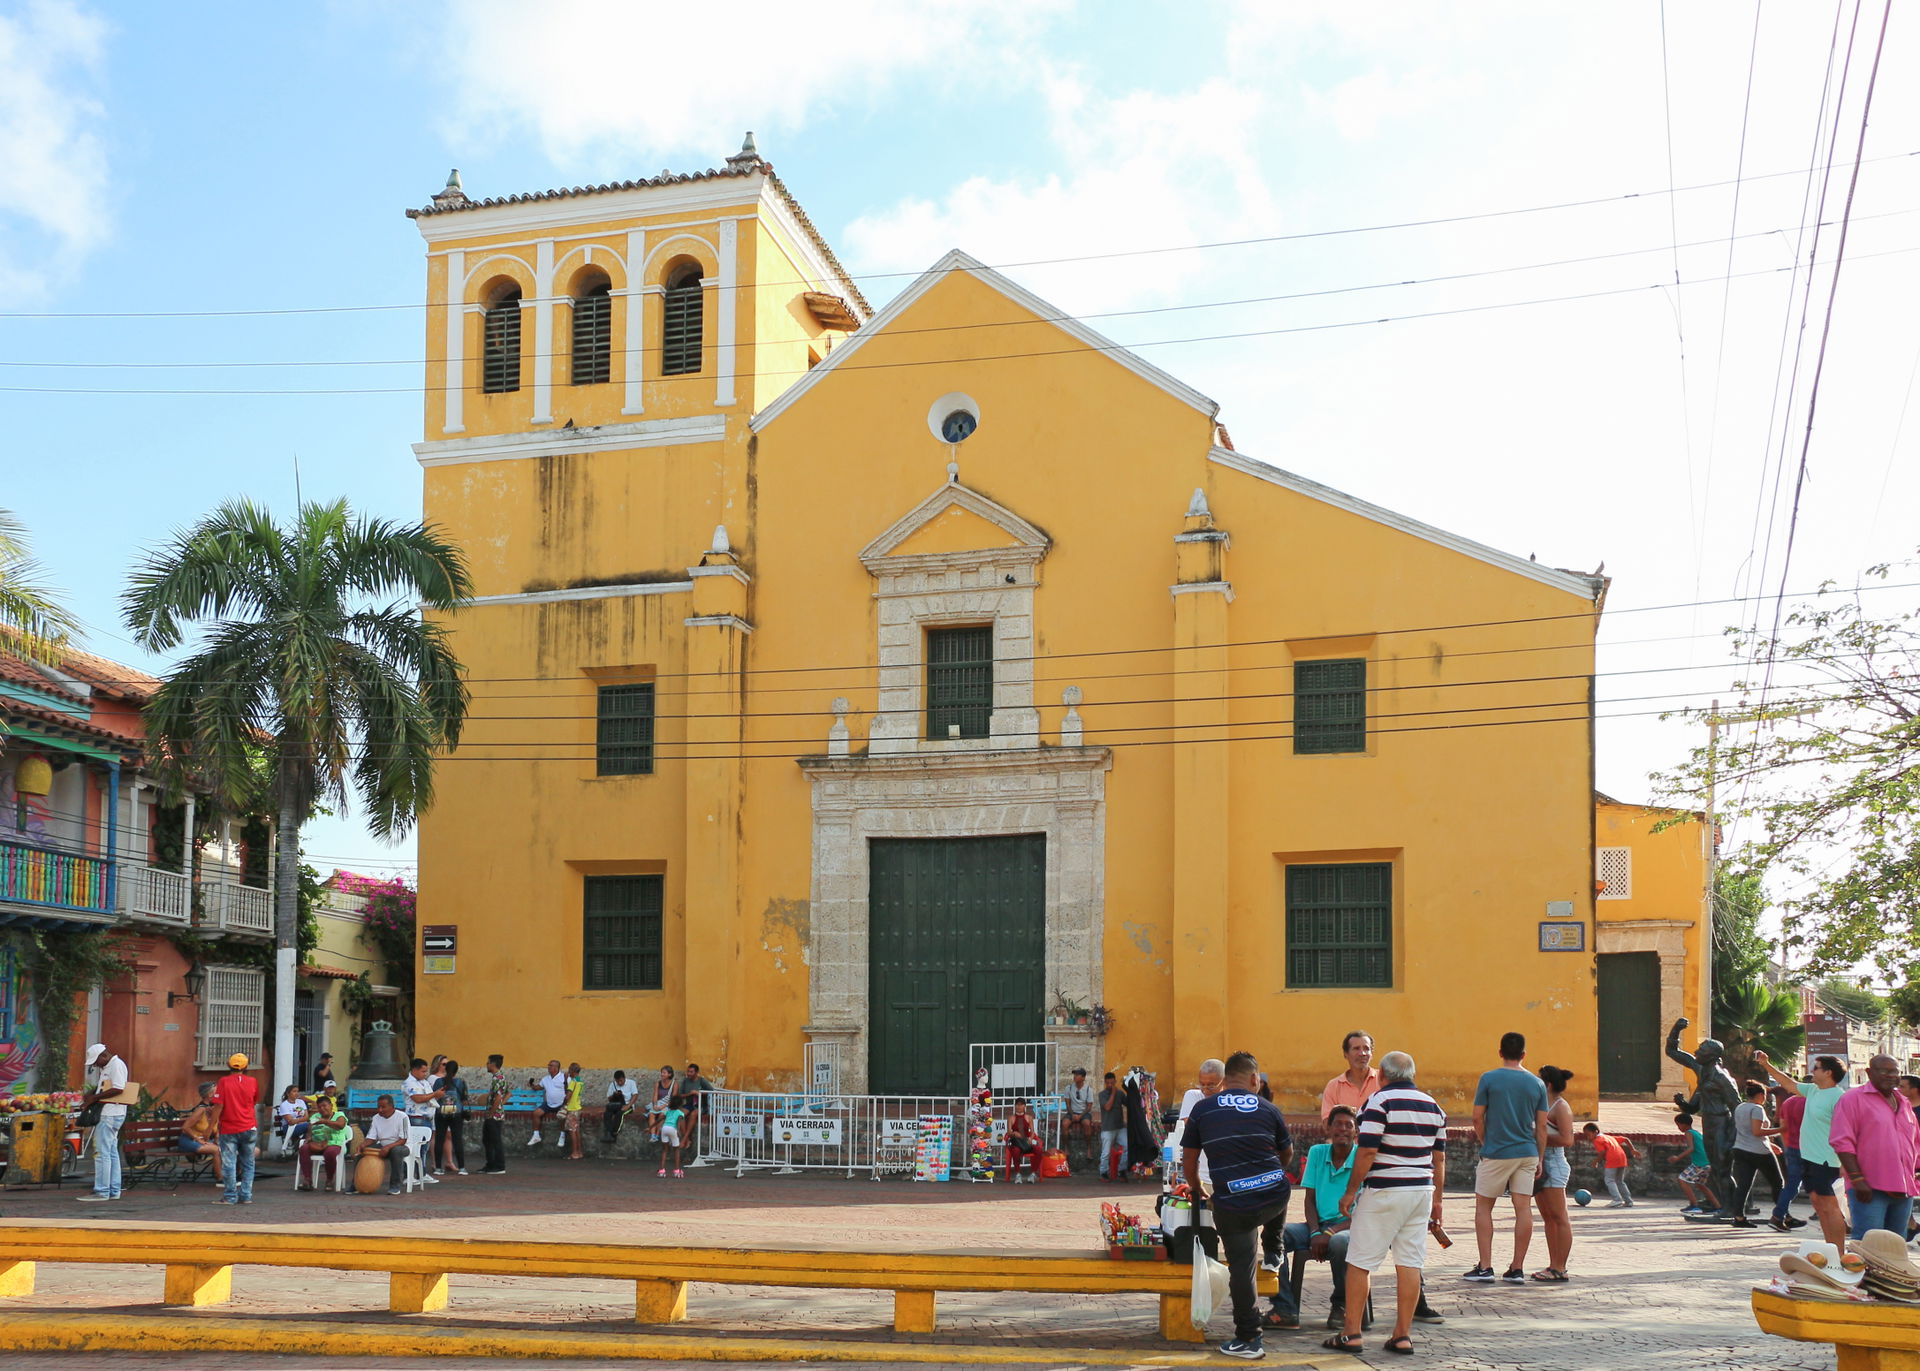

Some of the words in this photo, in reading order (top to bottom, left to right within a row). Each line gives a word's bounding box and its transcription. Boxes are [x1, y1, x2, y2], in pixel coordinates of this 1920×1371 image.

[780, 1120, 794, 1129] VIA
[796, 1120, 835, 1129] CERRADA
[890, 1121, 904, 1130] VIA
[995, 1122, 1006, 1131] VIA
